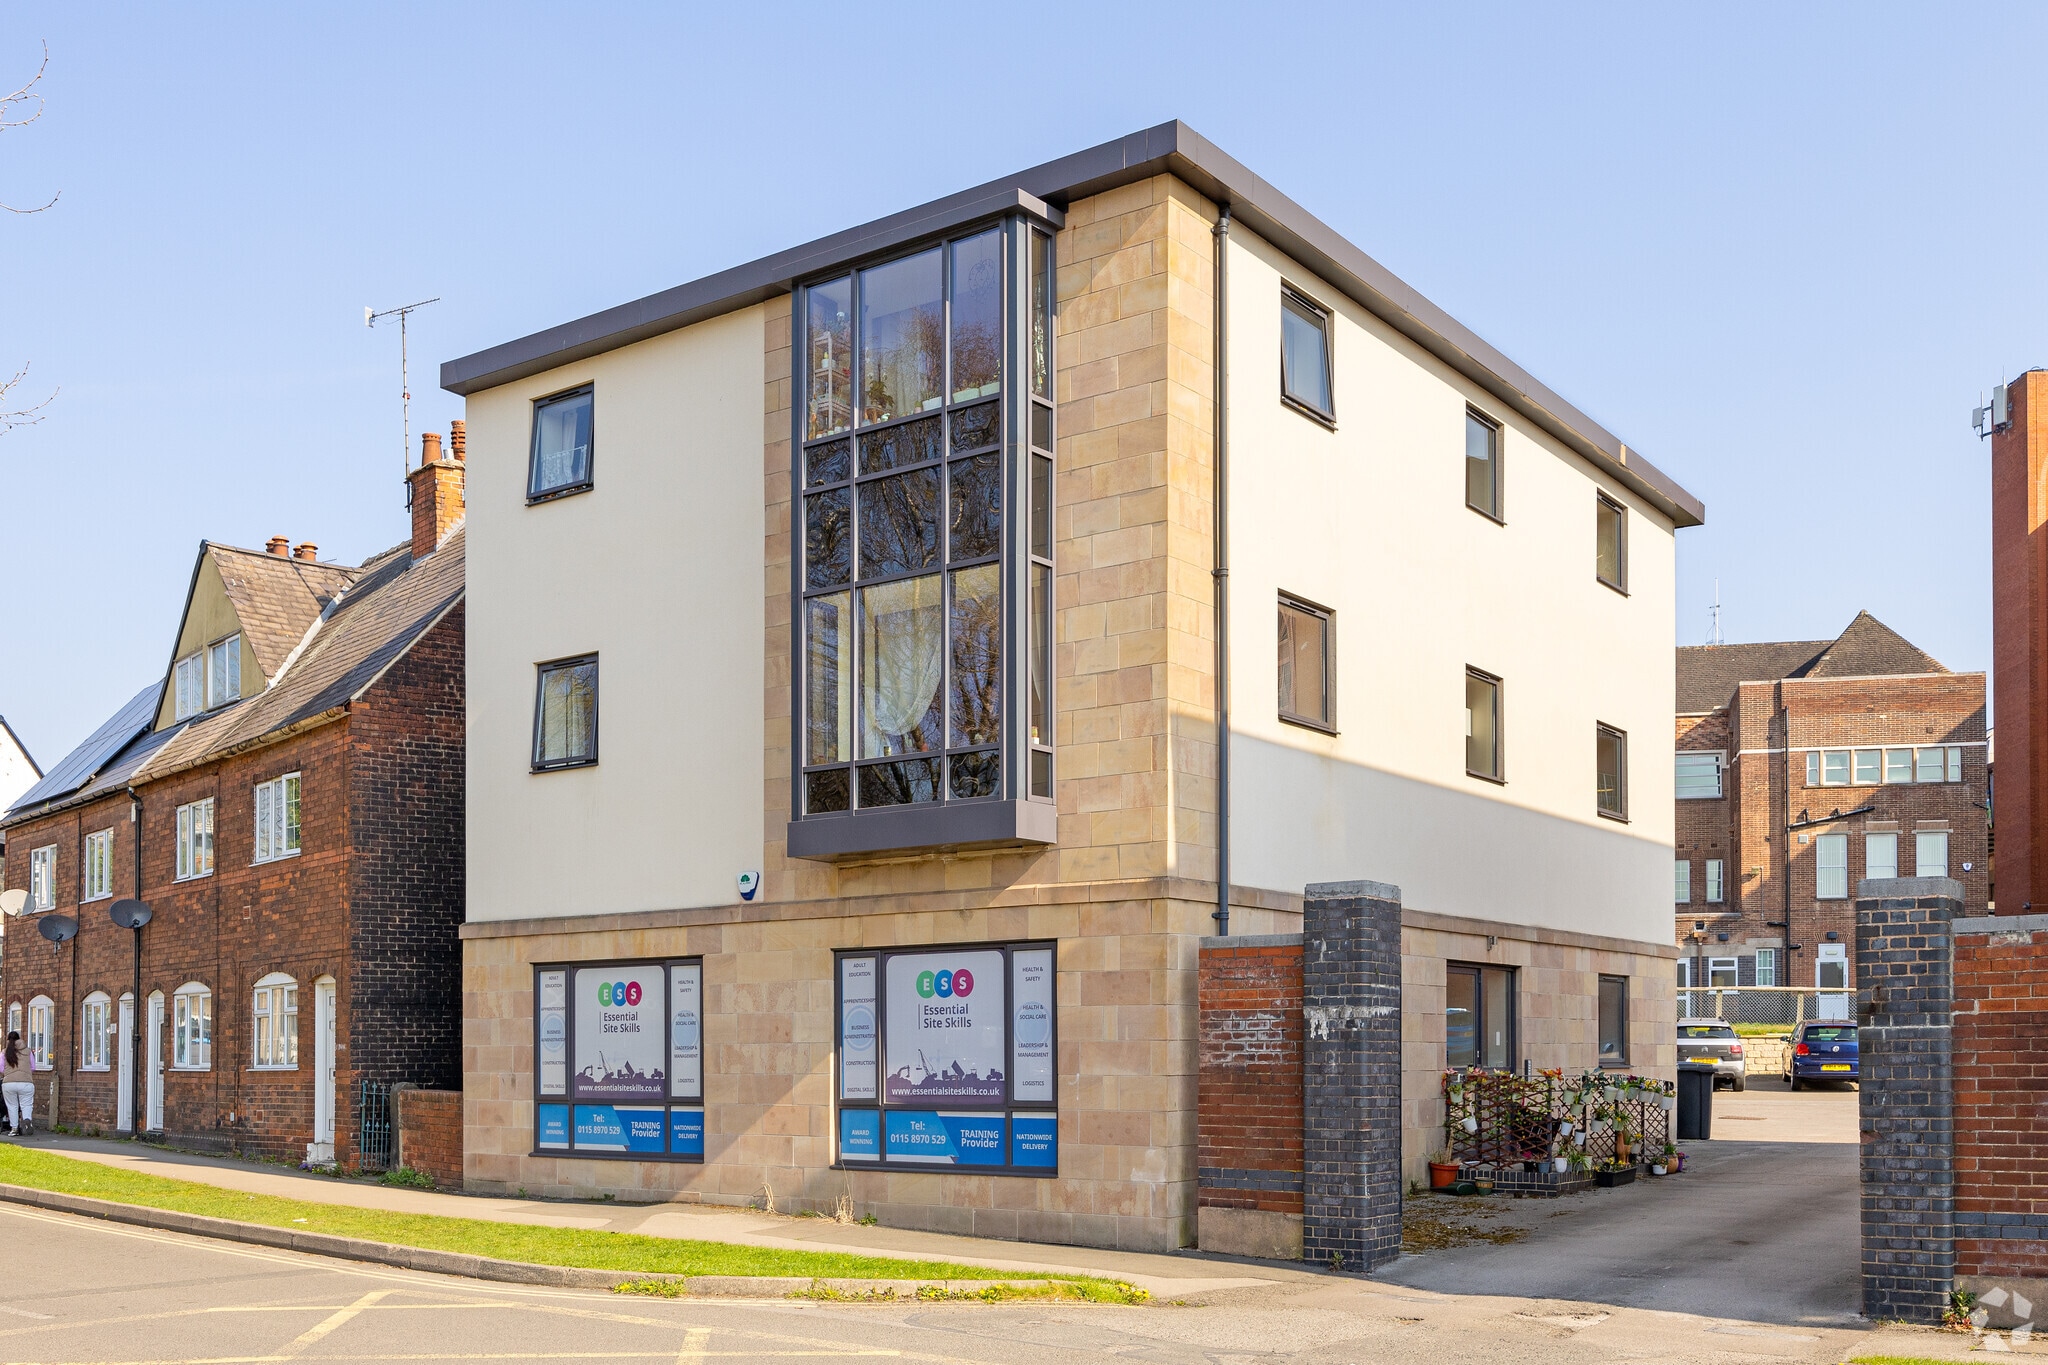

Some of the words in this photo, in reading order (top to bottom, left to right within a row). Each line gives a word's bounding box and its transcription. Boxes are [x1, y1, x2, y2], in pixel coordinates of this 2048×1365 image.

[923, 1003, 969, 1016] Essential
[603, 1011, 639, 1022] Essential
[603, 1023, 619, 1033] Site
[619, 1023, 641, 1033] Skills
[923, 1017, 943, 1029] Site
[944, 1017, 972, 1028] Skills
[578, 1083, 662, 1093] www.essentialsiteskills.co.uk
[891, 1086, 1001, 1097] www.essentialsiteskills.co.uk
[592, 1113, 605, 1123] Tel:
[577, 1125, 593, 1134] 0115
[593, 1125, 608, 1135] 8970
[608, 1126, 621, 1135] 529
[630, 1121, 661, 1130] TRAINING
[910, 1121, 926, 1131] Tel:
[631, 1128, 661, 1138] Provider
[677, 1132, 699, 1140] DELIVERY
[960, 1129, 999, 1139] TRAINING
[1016, 1133, 1053, 1142] NATIONWIDE
[890, 1134, 909, 1143] 0115
[910, 1134, 930, 1144] 8970
[931, 1135, 946, 1145] 529
[961, 1138, 999, 1149] Provider
[1022, 1143, 1049, 1151] DELIVERY
